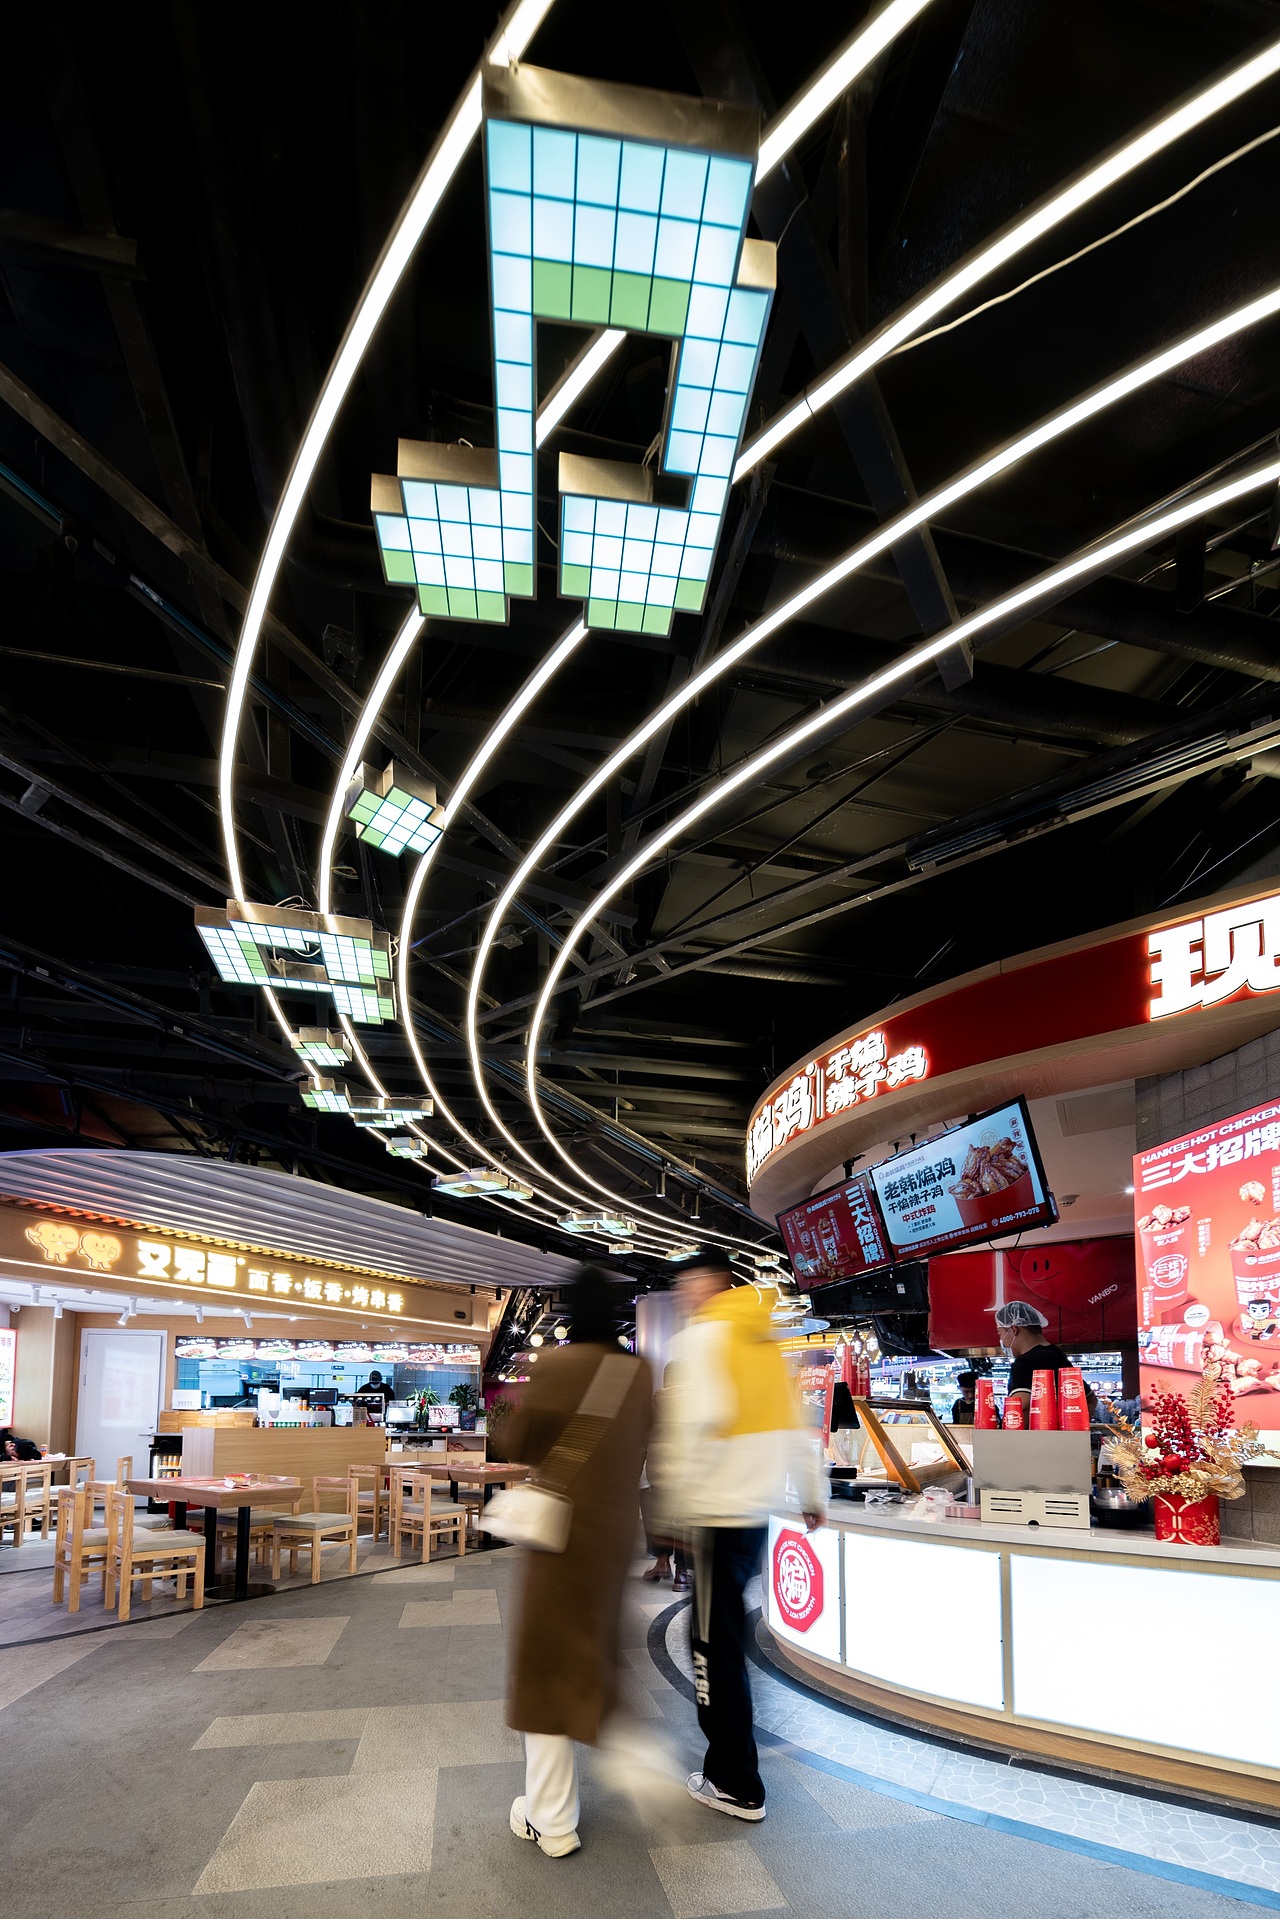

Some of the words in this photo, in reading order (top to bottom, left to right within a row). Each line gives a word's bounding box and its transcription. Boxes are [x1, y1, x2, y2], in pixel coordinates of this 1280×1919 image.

[1148, 894, 1280, 1021] 现
[825, 1046, 928, 1114] 辣子鸡
[1141, 1139, 1191, 1166] HANKEE
[1190, 1129, 1219, 1147] HOT
[1218, 1104, 1280, 1136] CHICKEN
[1141, 1121, 1280, 1193] 三大招牌
[884, 1157, 957, 1201] 老韩煸鸡
[888, 1185, 944, 1215] 干煸辣子鸡
[845, 1184, 881, 1265] 三大招牌
[868, 1212, 878, 1228] HOT
[902, 1204, 937, 1223] 中式炸鸡
[777, 1540, 789, 1564] HANKEE
[787, 1540, 798, 1548] HOT
[796, 1543, 816, 1577] CHICKEN
[799, 1595, 817, 1620] HANKEE
